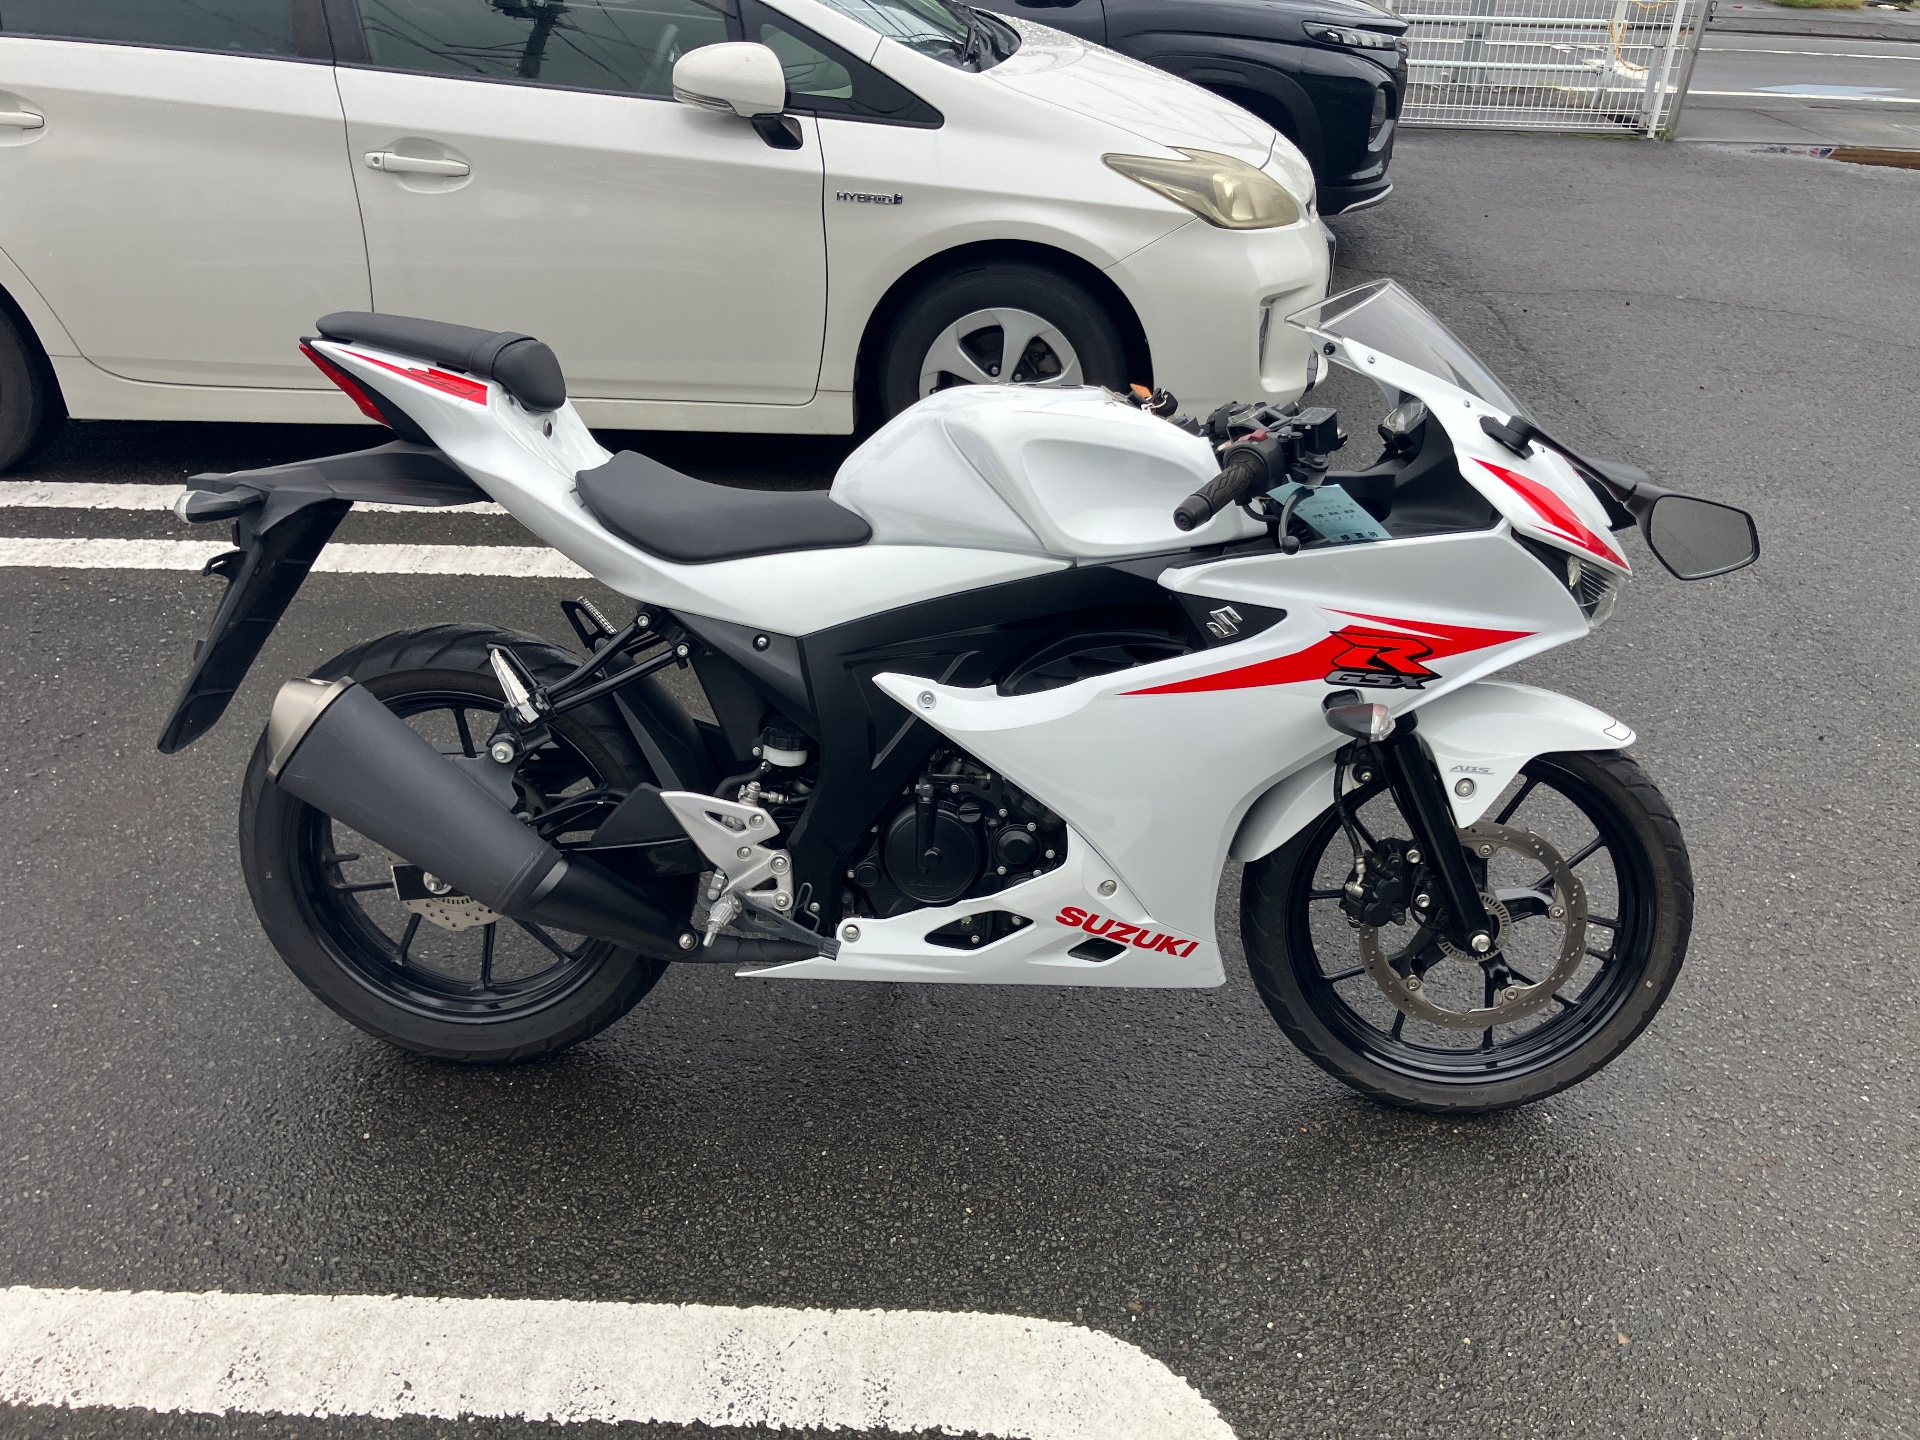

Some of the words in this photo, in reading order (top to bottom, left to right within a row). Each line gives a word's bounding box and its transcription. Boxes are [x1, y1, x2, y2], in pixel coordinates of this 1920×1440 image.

[836, 190, 893, 205] HYBRID
[1329, 630, 1441, 676] R
[1324, 670, 1427, 689] GSX
[1449, 765, 1495, 775] ABS
[1055, 906, 1200, 958] SUZUKI
